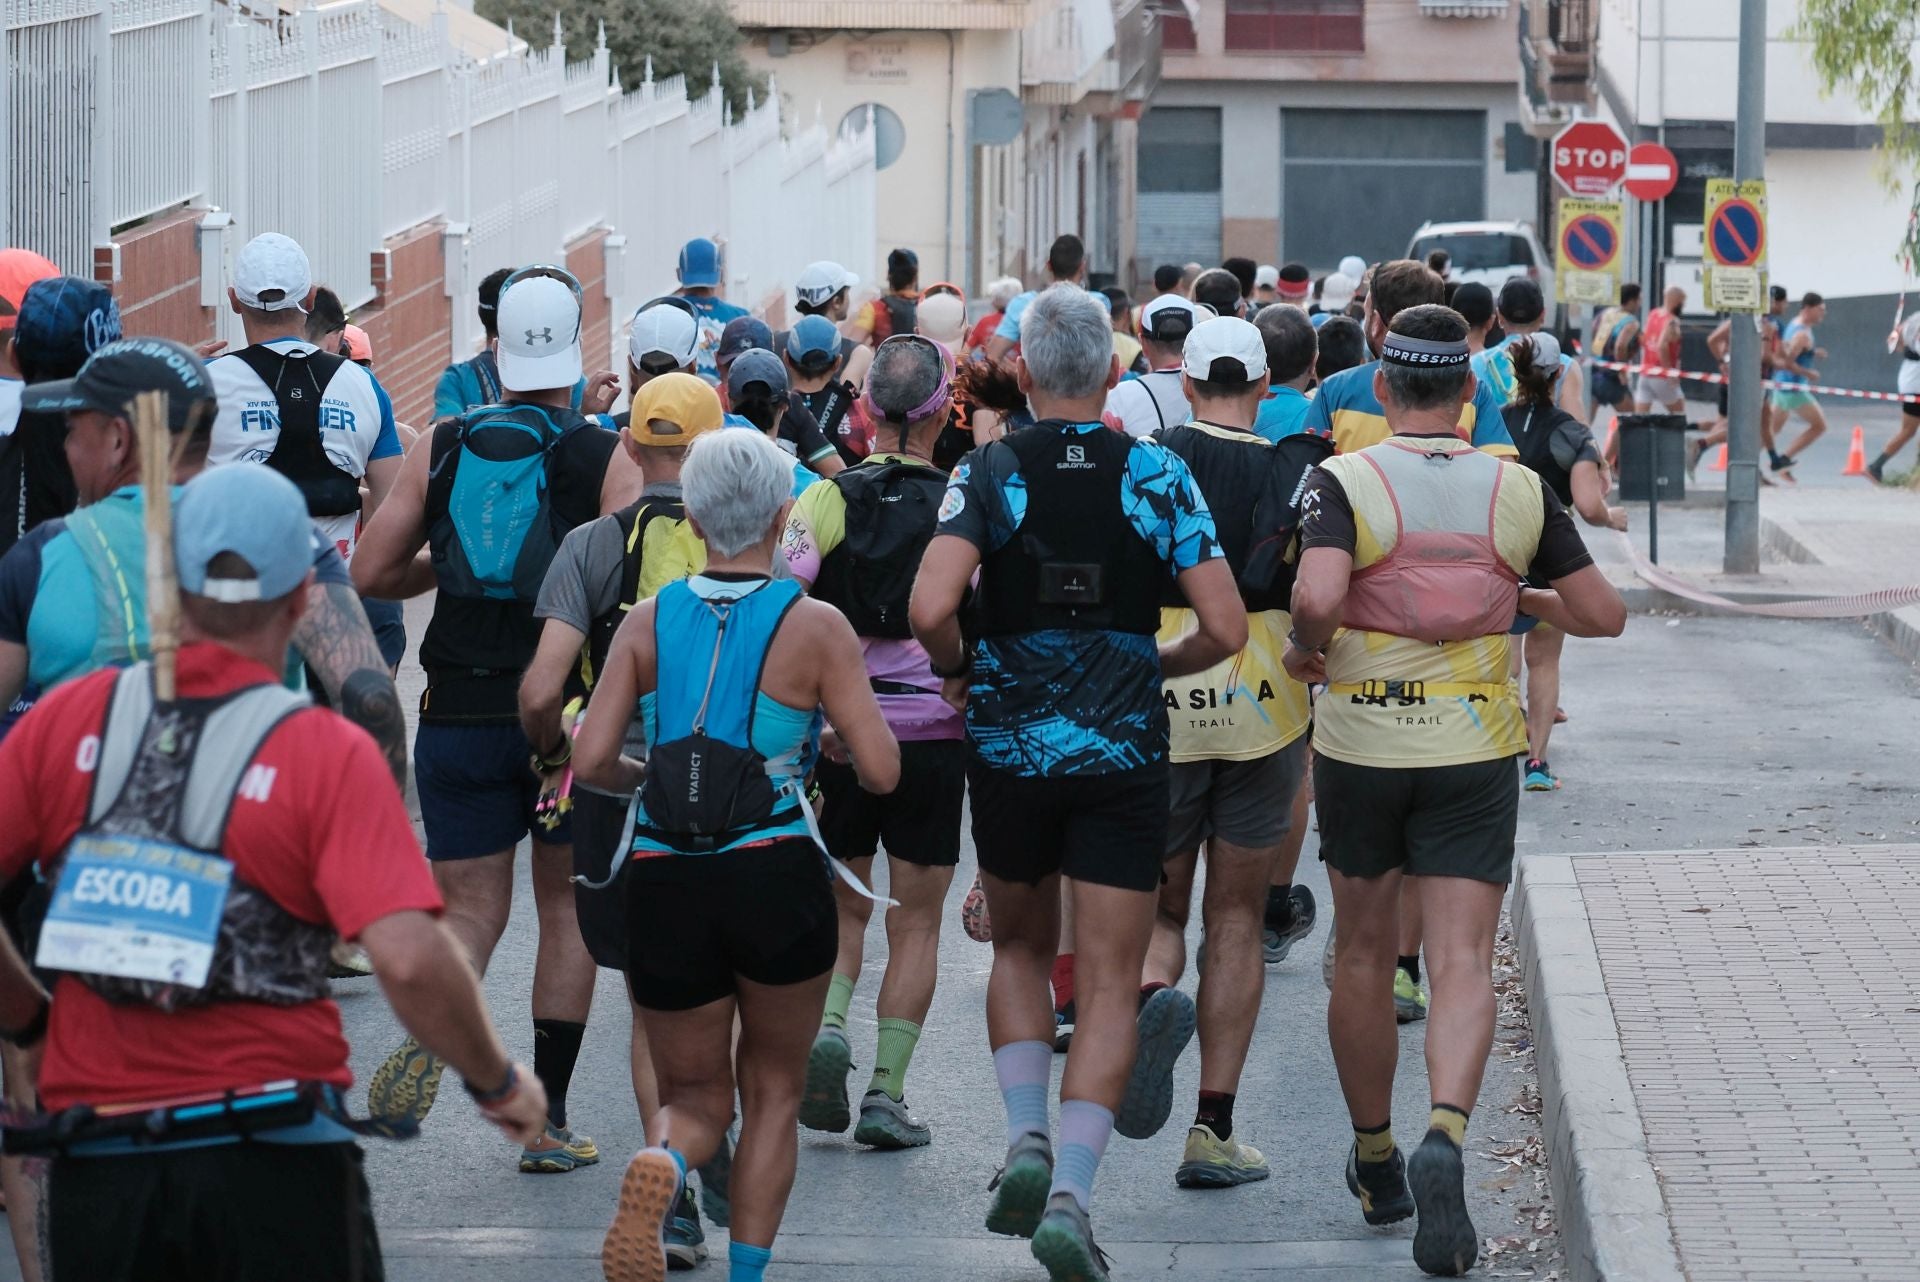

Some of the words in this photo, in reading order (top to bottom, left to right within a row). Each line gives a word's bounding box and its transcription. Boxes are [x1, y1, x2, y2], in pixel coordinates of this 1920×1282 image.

[1557, 147, 1625, 169] STOP
[1382, 345, 1470, 365] OMPRESSPORT
[1189, 717, 1235, 729] TRAIL
[1395, 716, 1443, 726] TRAIL
[688, 751, 702, 803] EVADICT
[73, 868, 192, 918] ESCOBA
